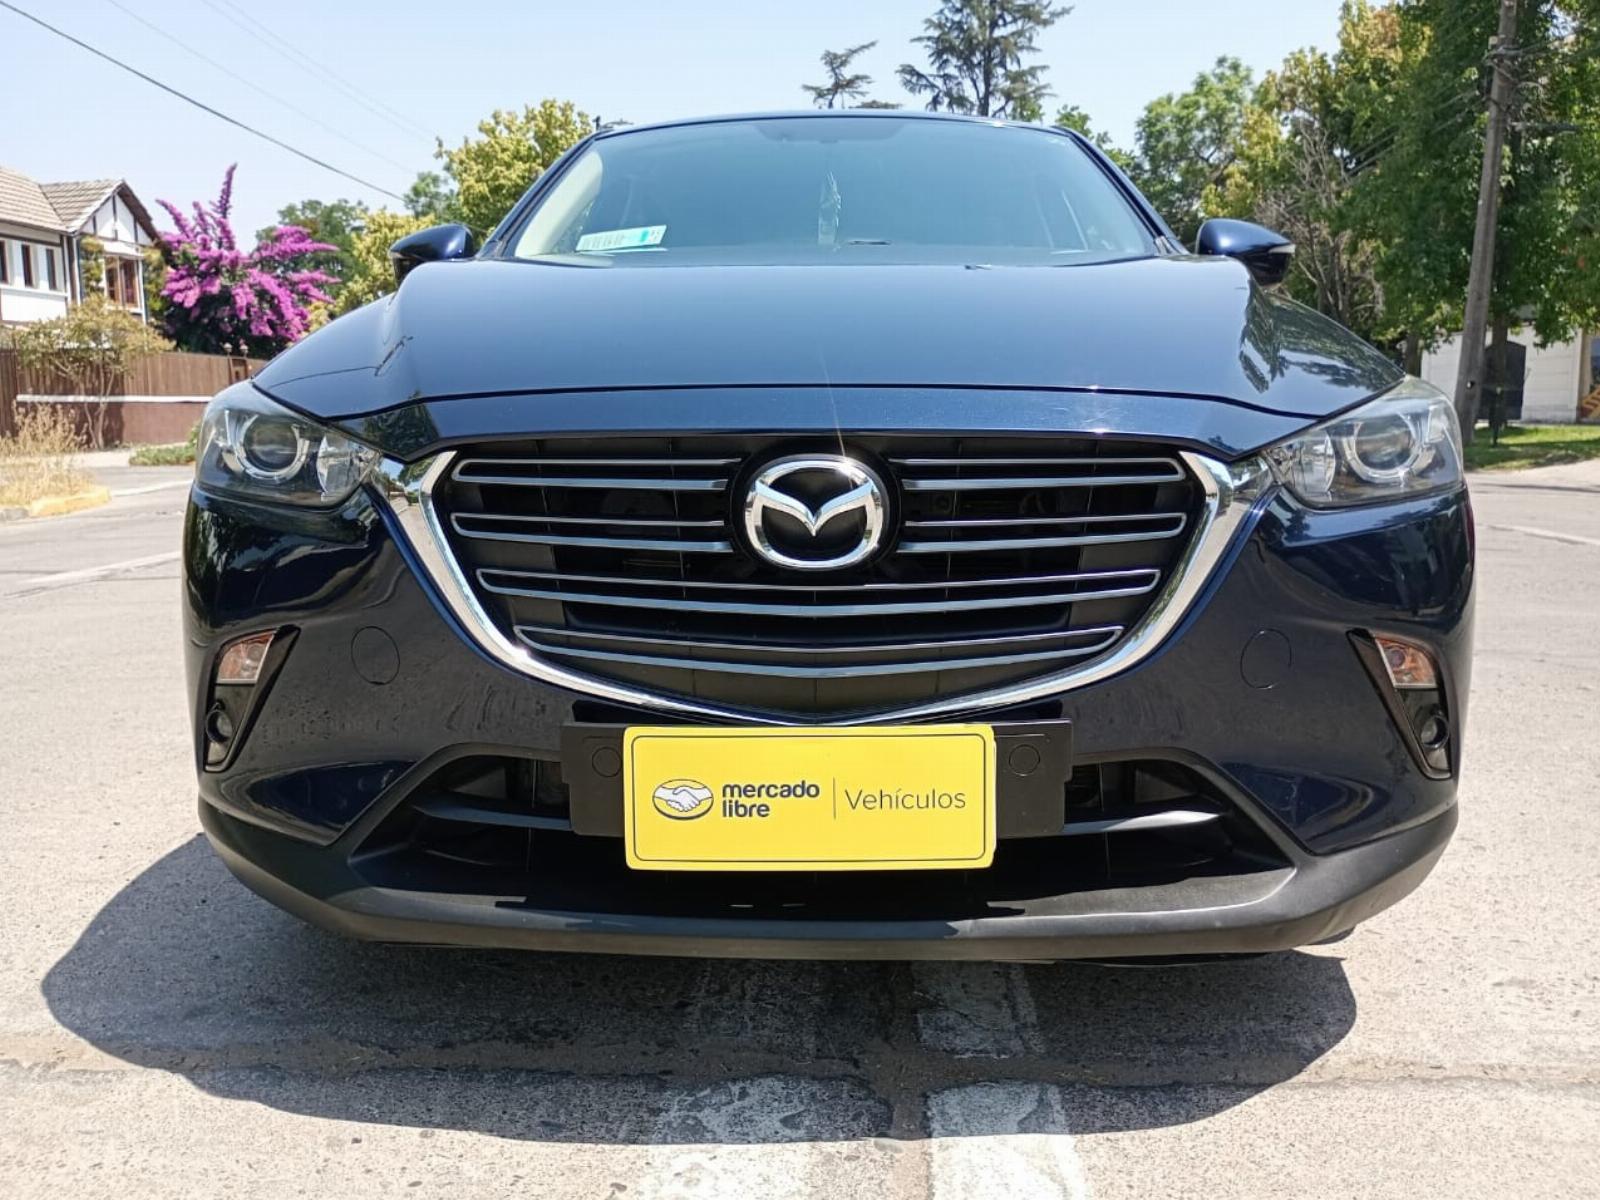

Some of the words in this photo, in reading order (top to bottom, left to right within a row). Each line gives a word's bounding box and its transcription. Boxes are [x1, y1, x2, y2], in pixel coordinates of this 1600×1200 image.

[722, 780, 819, 798] mercado
[845, 788, 966, 810] Vehículos
[722, 800, 770, 818] libre
